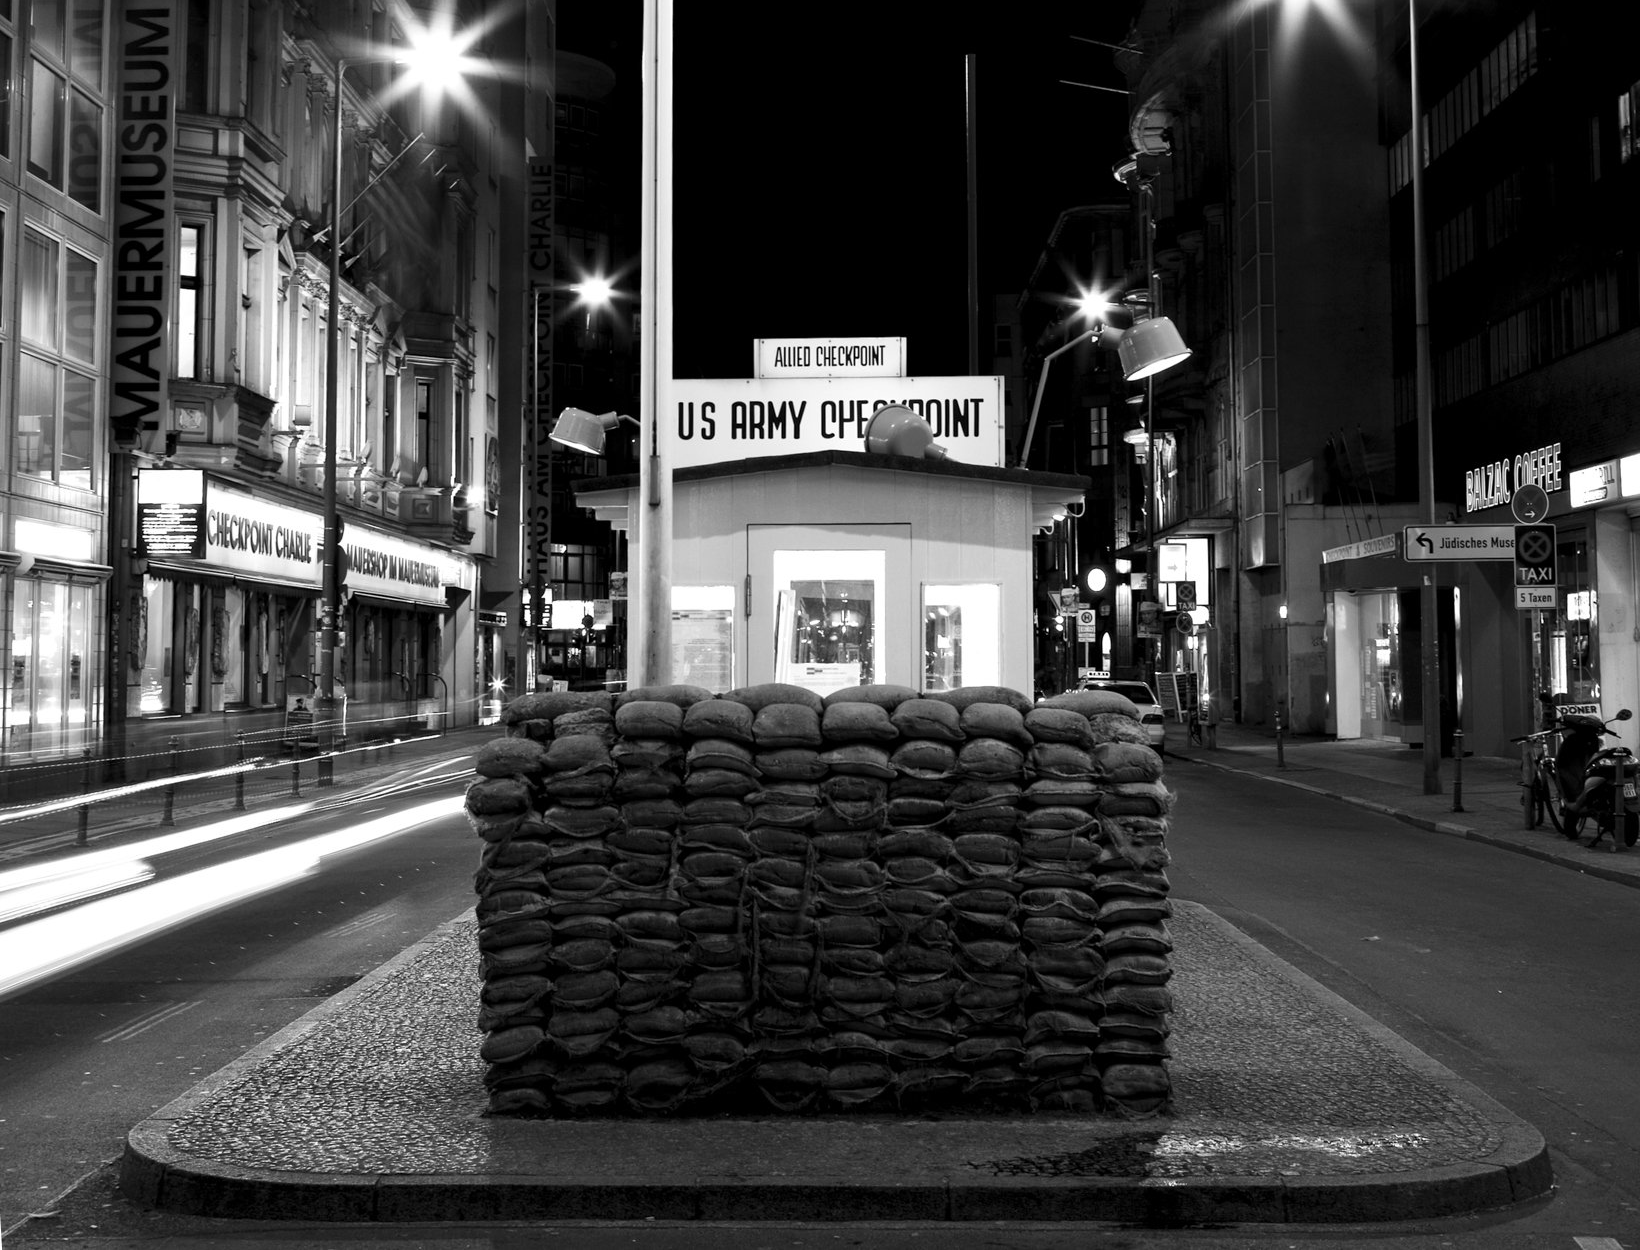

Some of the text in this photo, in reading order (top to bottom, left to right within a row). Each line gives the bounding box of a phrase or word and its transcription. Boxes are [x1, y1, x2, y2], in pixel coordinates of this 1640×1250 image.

[115, 8, 171, 431] MAUERMUSEUM
[529, 165, 552, 271] CHARLIE
[774, 345, 886, 368] ALLIED CHECKPOINT
[678, 398, 984, 440] US ARMY CHEOINT
[1466, 458, 1511, 513] BALZAC
[1514, 442, 1562, 493] COFFEE
[207, 509, 274, 557] CHECKPOINT
[275, 525, 311, 564] CHARLIE
[1440, 537, 1515, 549] Jüdisches Muse
[1519, 567, 1552, 581] TAXI
[1178, 602, 1195, 610] TAXI
[1520, 593, 1552, 603] 5 Taxen
